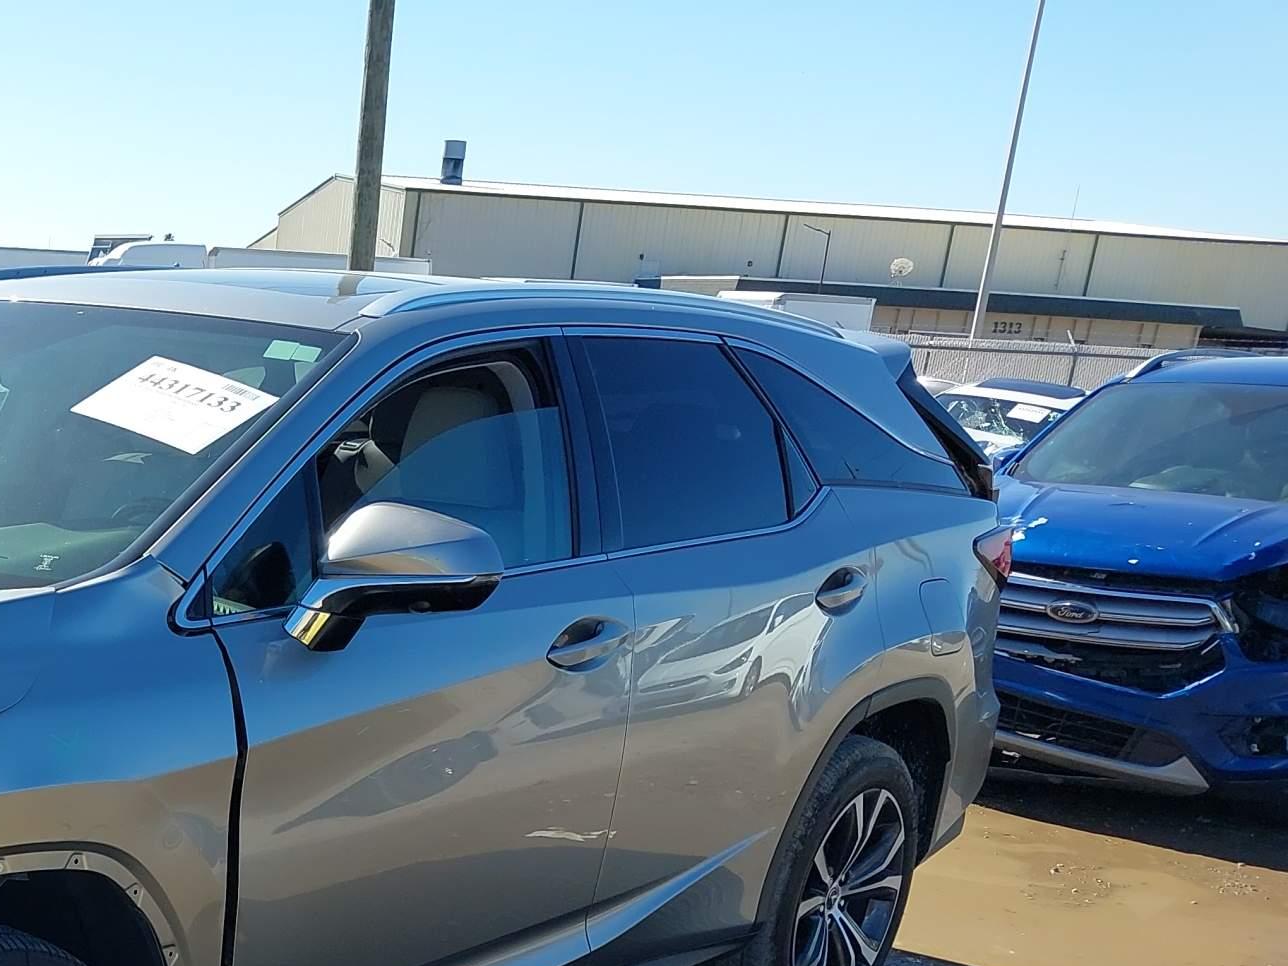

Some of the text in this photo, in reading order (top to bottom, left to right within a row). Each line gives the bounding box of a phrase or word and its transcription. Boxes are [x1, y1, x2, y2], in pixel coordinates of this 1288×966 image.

[992, 321, 1022, 335] 1313
[138, 373, 242, 413] 44317133
[1058, 607, 1085, 619] Ford
